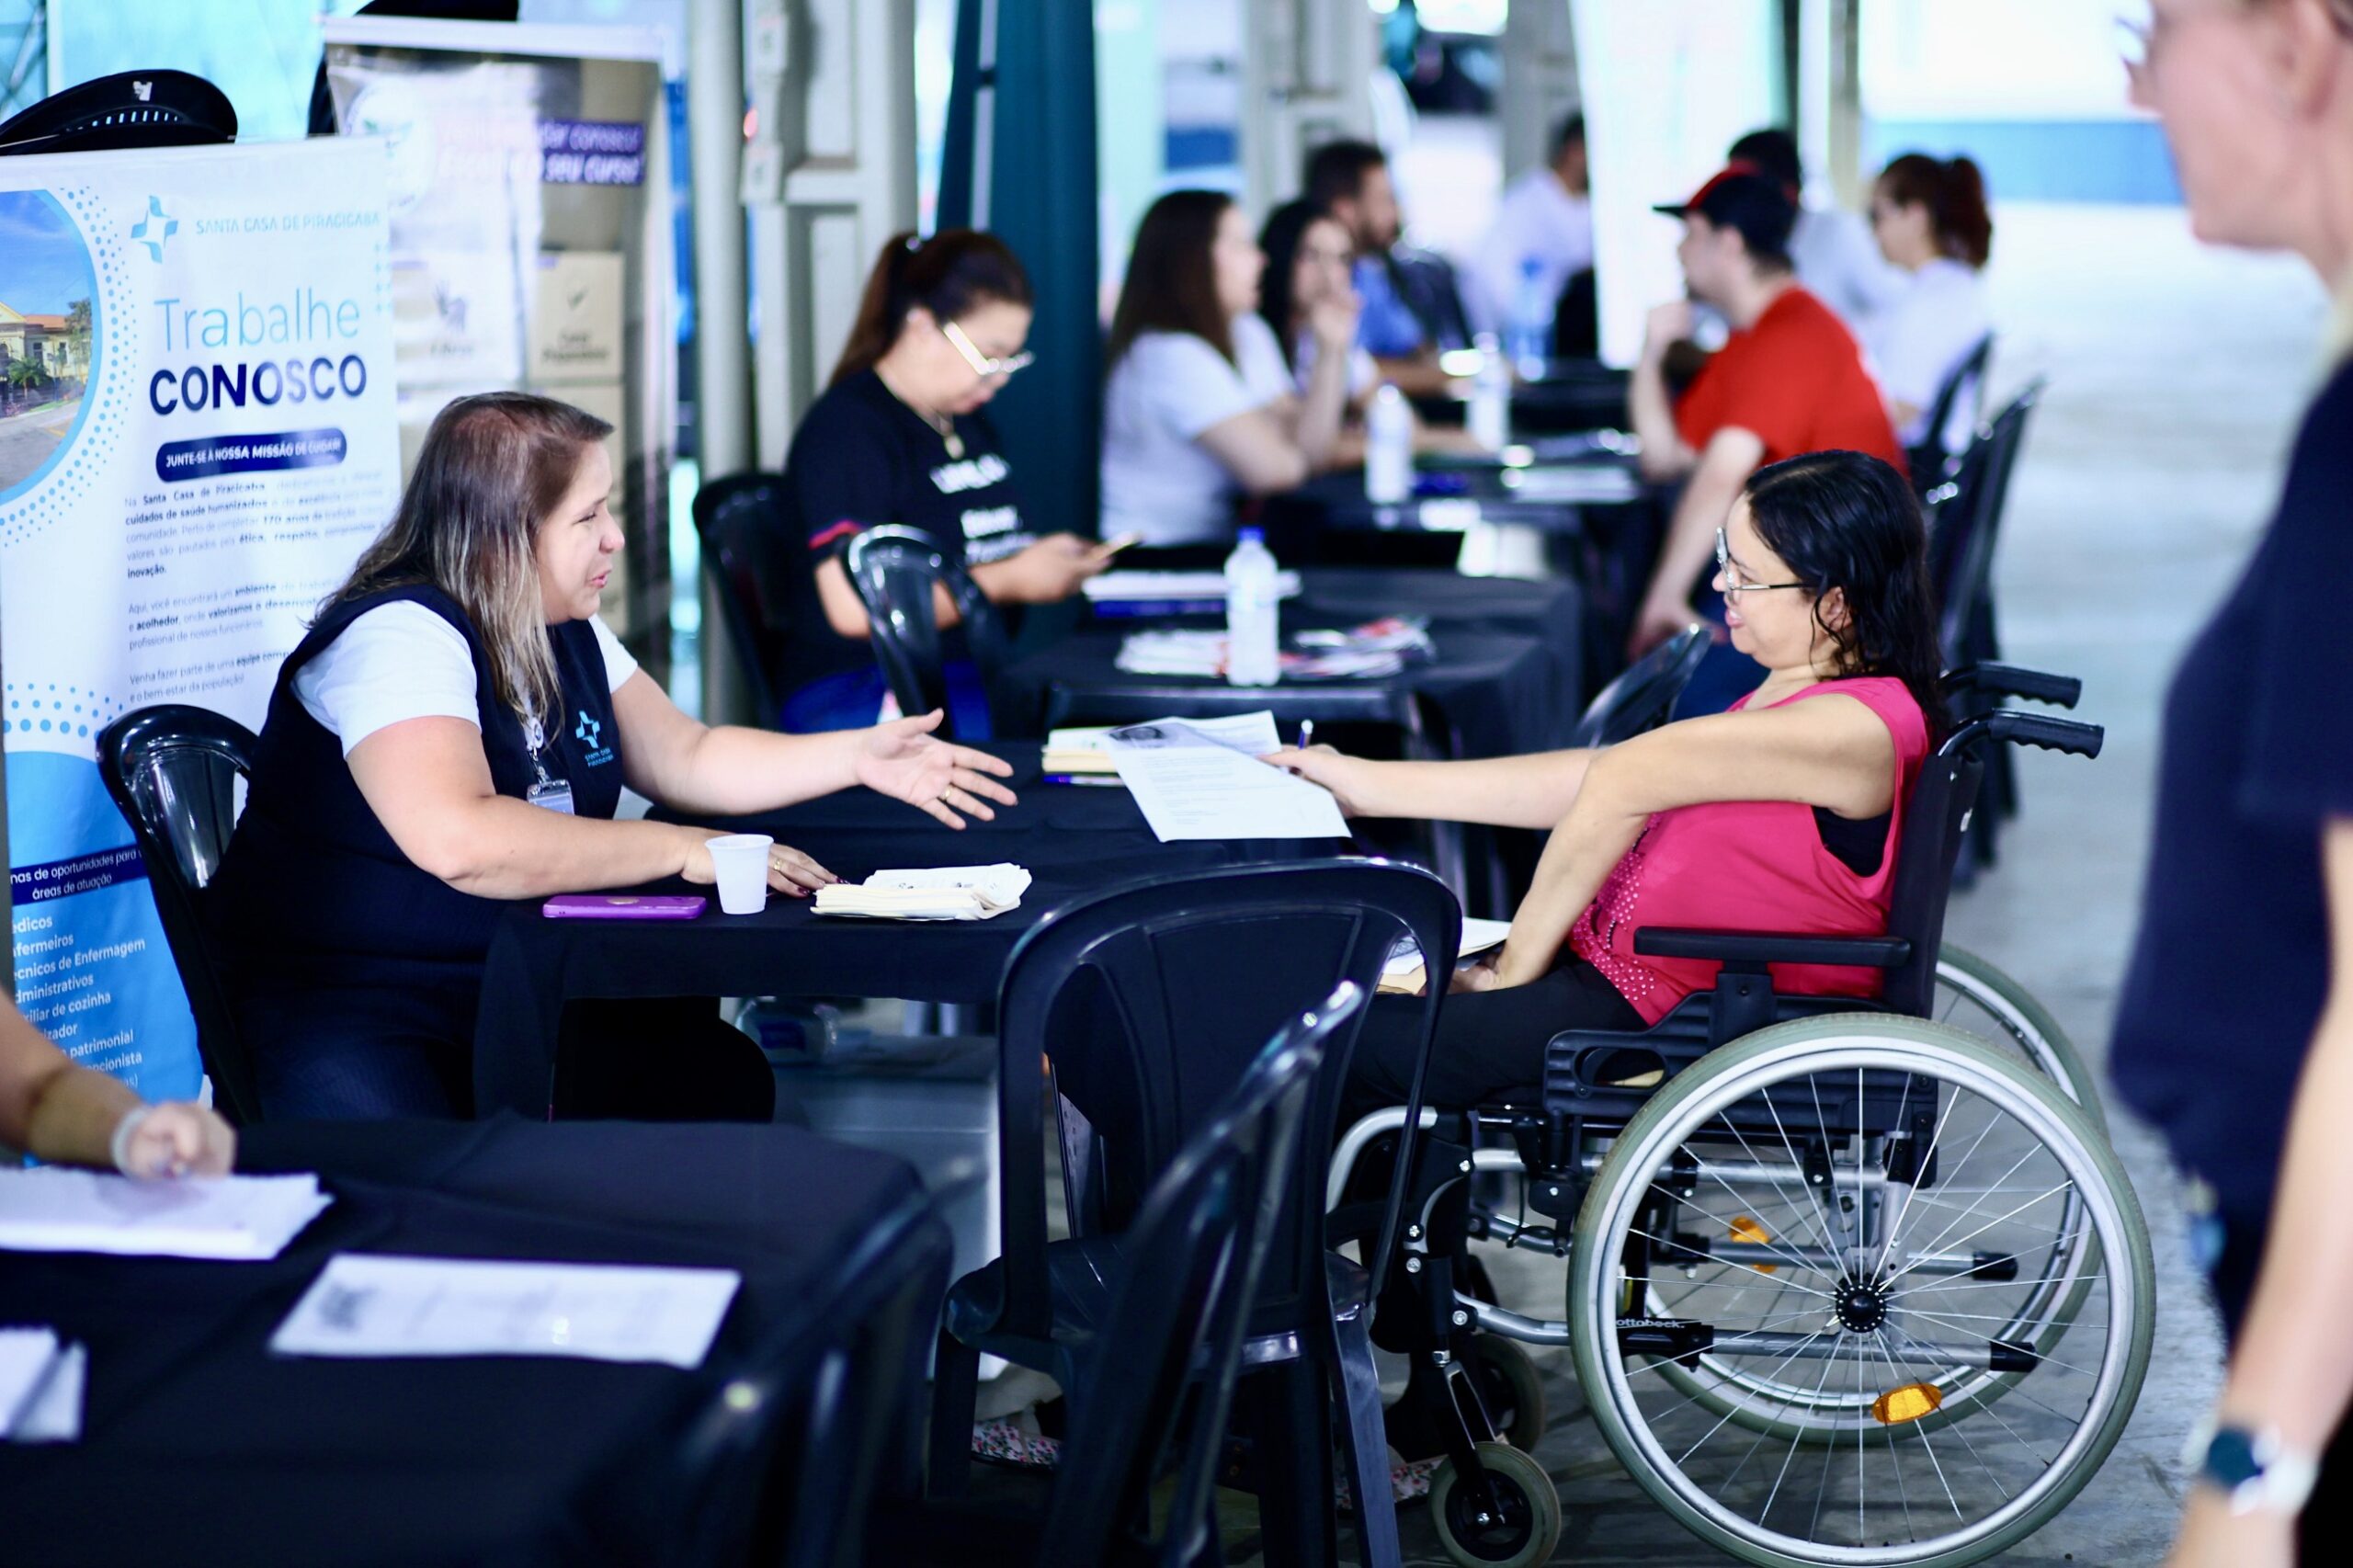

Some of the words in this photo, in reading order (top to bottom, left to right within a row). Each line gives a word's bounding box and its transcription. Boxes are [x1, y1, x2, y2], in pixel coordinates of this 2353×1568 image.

[196, 217, 239, 235] SANTA
[244, 215, 278, 233] CASA
[282, 213, 300, 231] DE
[302, 210, 381, 230] PIRACICABA
[153, 286, 360, 353] Trabalhe
[149, 354, 368, 416] CONOSCO
[215, 445, 250, 461] NOSSA
[252, 441, 293, 459] MISSÃO
[142, 493, 166, 506] Santa
[174, 489, 195, 502] Casa
[200, 487, 210, 497] de
[215, 482, 265, 495] Piracicaba
[125, 510, 164, 525] cuidados
[166, 508, 177, 519] de
[180, 505, 206, 518] saúde
[208, 499, 267, 515] humanizados
[127, 548, 154, 562] valores
[127, 563, 167, 579] inovação.
[151, 598, 170, 611] você
[234, 583, 277, 597] ambiente
[208, 603, 253, 619] valorizamos
[129, 632, 175, 652] profissional
[176, 631, 188, 642] de
[130, 672, 155, 686] Venha
[157, 668, 177, 680] fazer
[180, 665, 203, 677] parte
[204, 661, 215, 672] de
[217, 658, 234, 669] uma
[235, 653, 260, 669] equipe
[189, 681, 199, 693] da
[34, 866, 49, 881] de
[51, 855, 114, 881] oportunidades
[115, 848, 137, 867] para
[32, 883, 62, 901] áreas
[63, 879, 75, 893] de
[76, 874, 112, 892] atuação
[13, 915, 53, 935] dicos
[13, 933, 74, 959] fermeiros
[14, 960, 56, 981] cnicos
[58, 954, 72, 971] de
[74, 938, 146, 966] Enfermagem
[16, 973, 94, 1005] dministrativos
[51, 1000, 66, 1016] de
[68, 990, 111, 1014] cozinha
[70, 1028, 134, 1060] patrimonial
